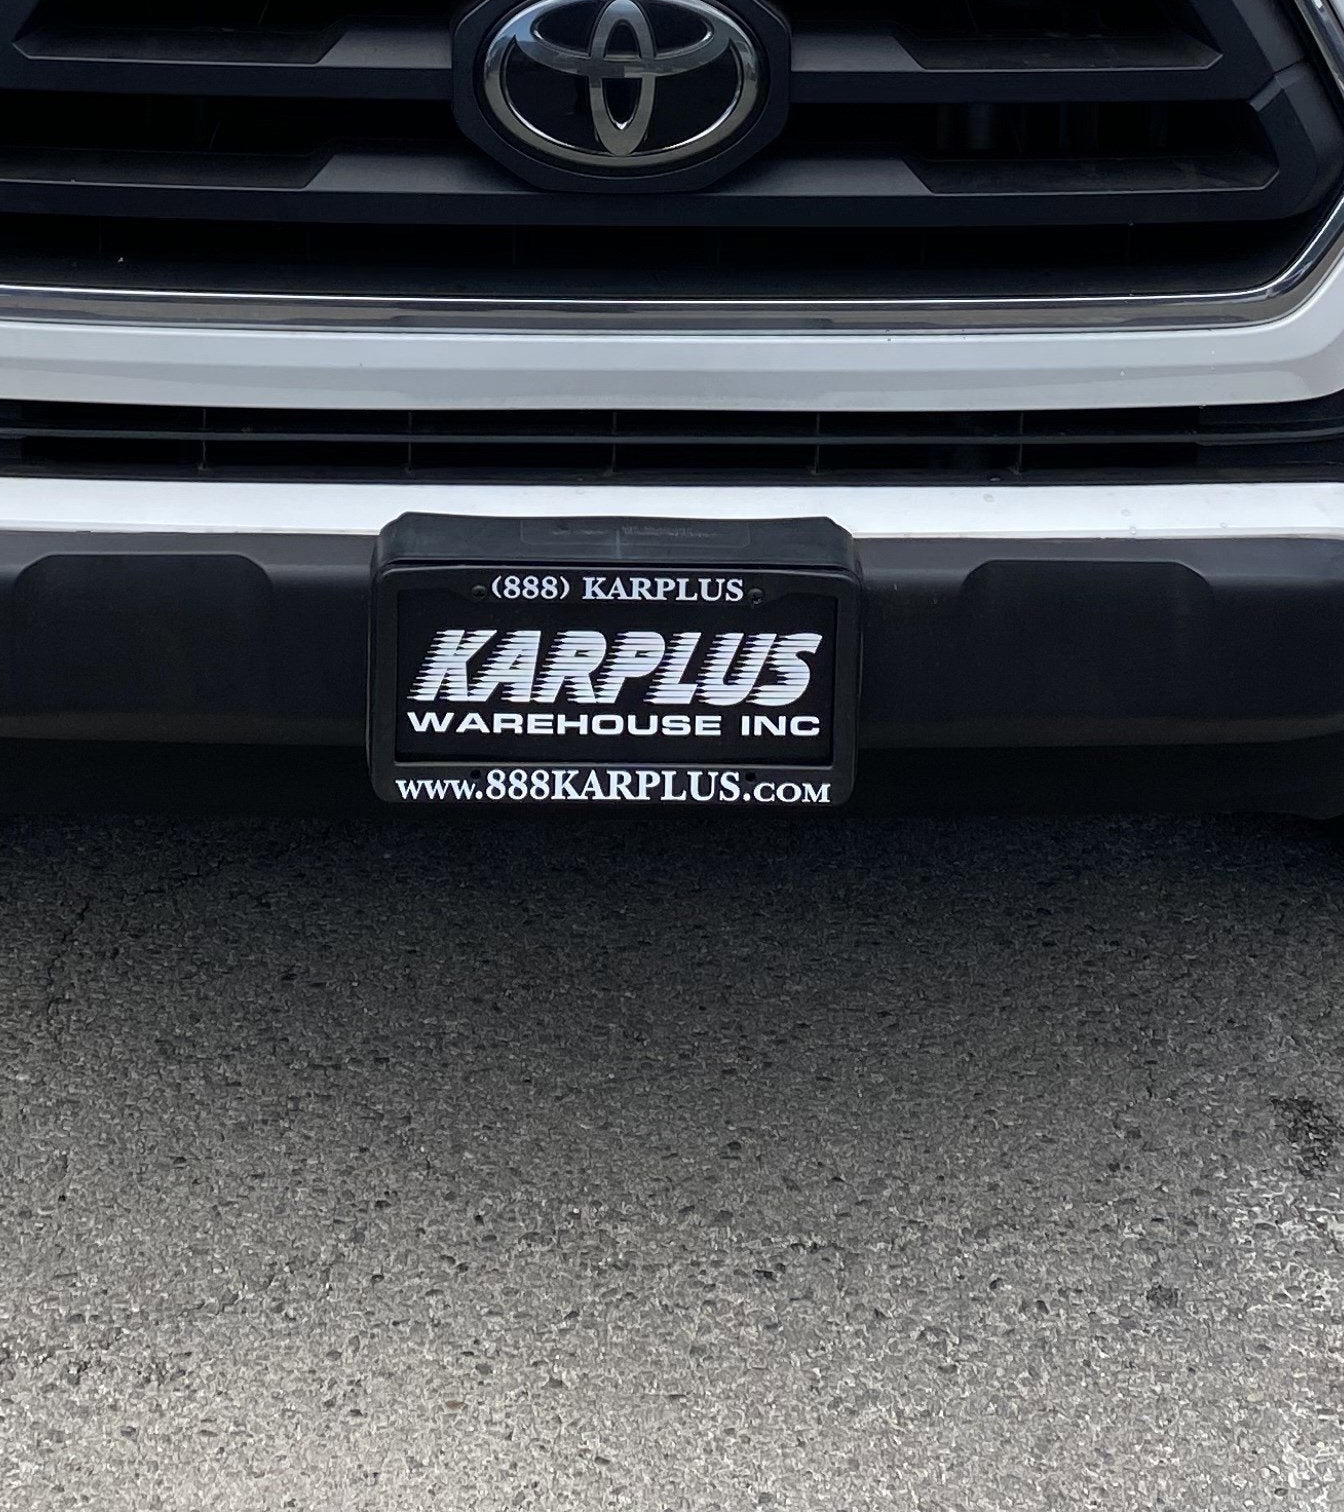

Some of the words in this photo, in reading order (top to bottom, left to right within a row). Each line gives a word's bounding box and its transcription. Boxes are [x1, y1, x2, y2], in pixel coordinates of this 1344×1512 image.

[491, 576, 570, 601] (888)
[582, 577, 744, 602] KARPLUS
[406, 629, 823, 706] KARPLUS
[406, 711, 721, 737] WAREHOUSE
[741, 715, 820, 736] INC
